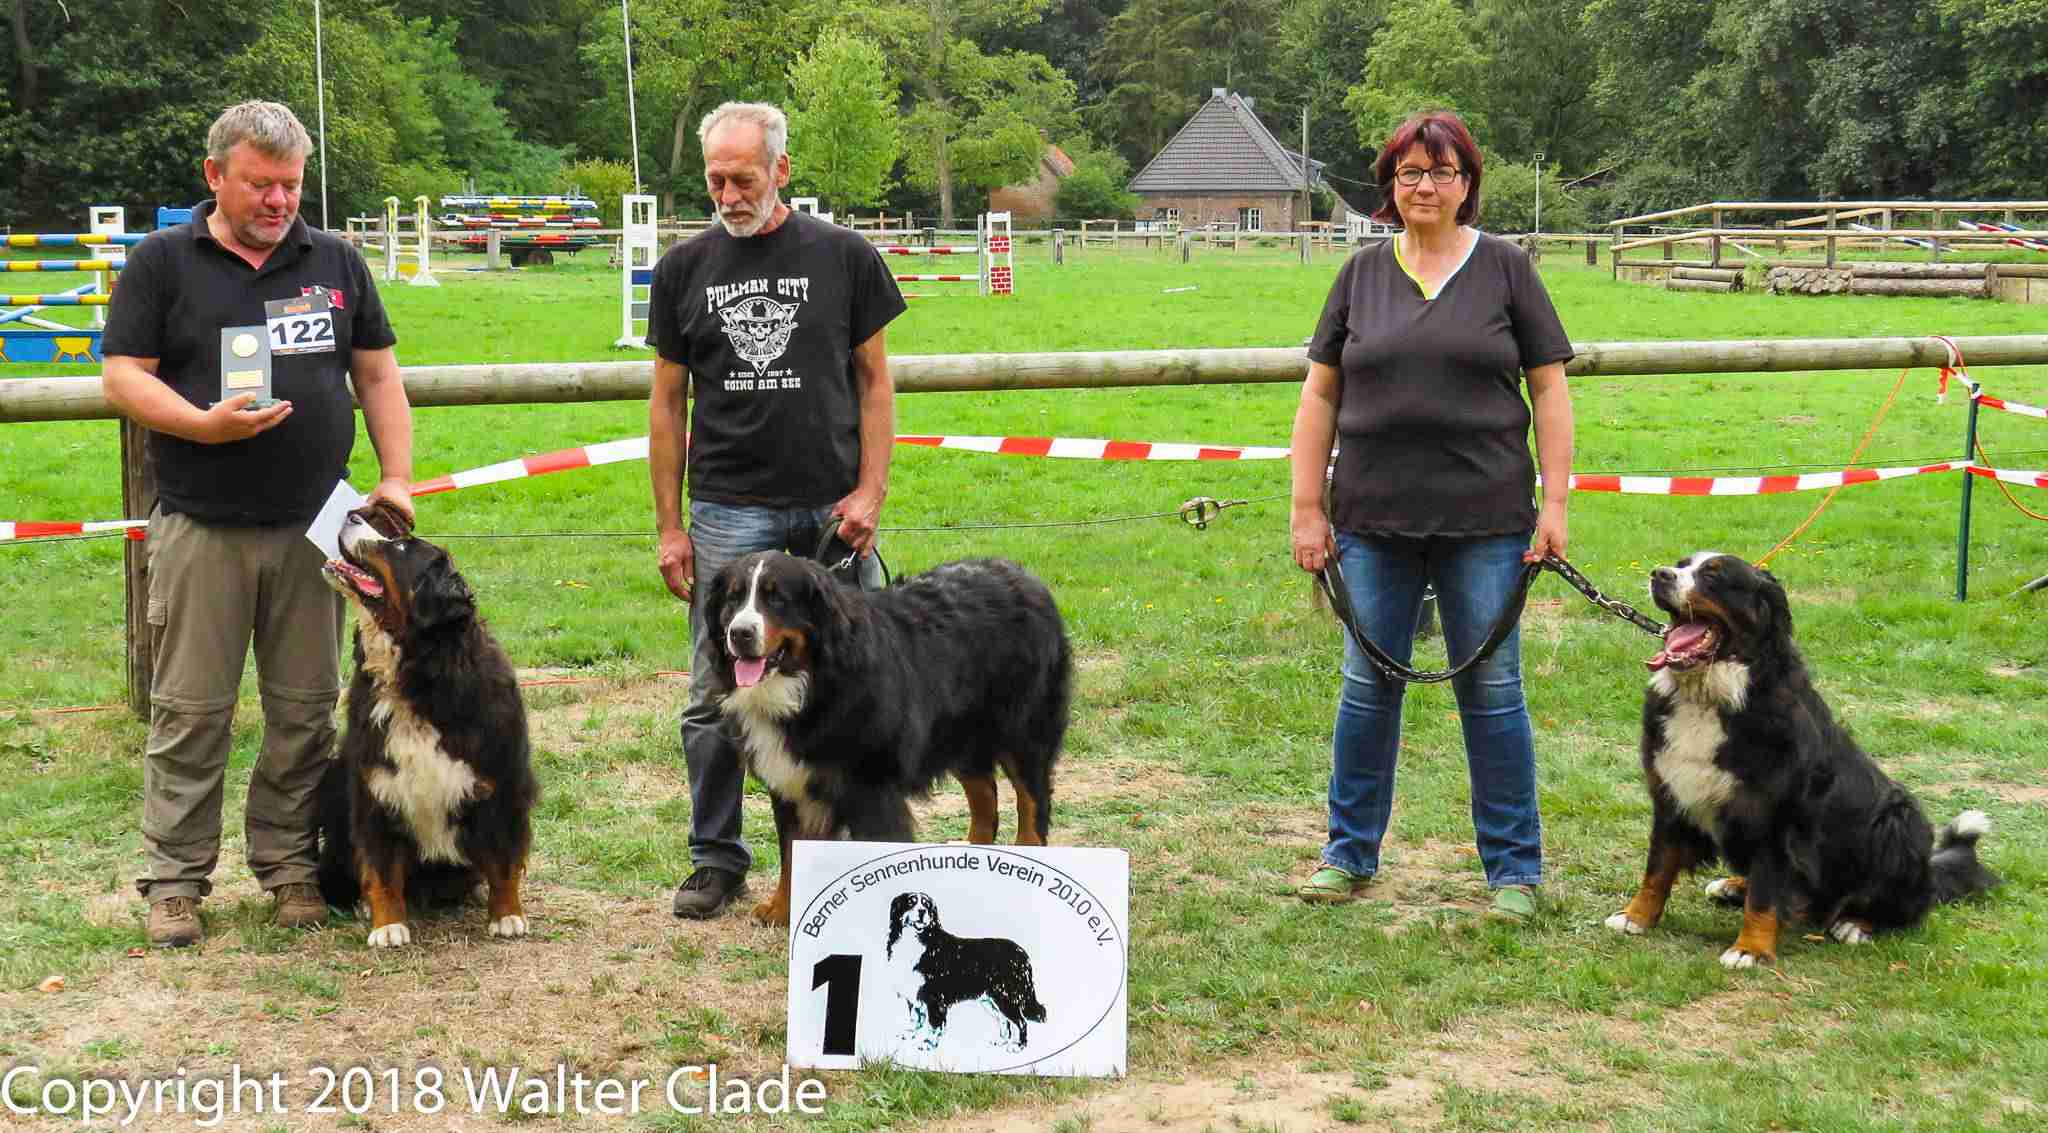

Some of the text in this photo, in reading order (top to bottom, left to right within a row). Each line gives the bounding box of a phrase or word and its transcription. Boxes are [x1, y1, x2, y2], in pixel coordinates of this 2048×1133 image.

[706, 277, 809, 314] PULLMAN CITY
[271, 318, 333, 345] 122
[802, 852, 1114, 947] Berner Sennenhunde Verein 2010 e.V.
[811, 954, 862, 1056] 1
